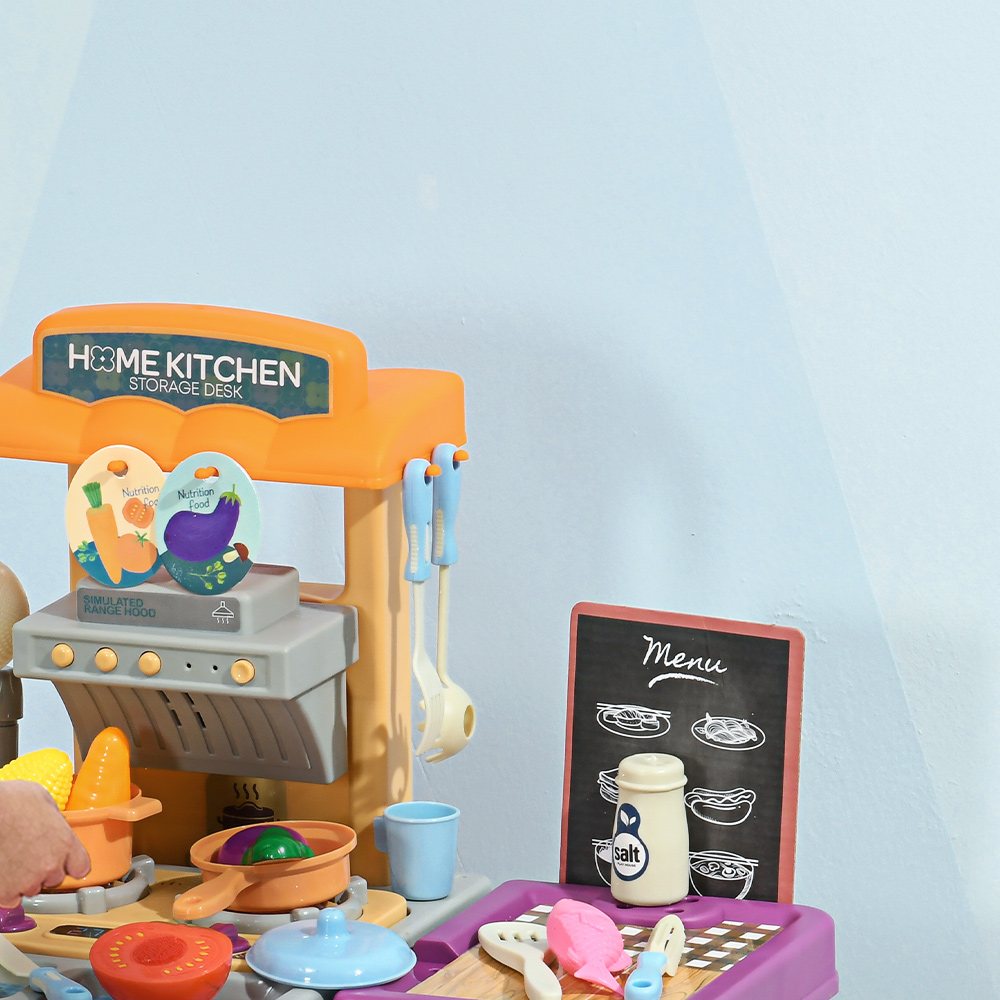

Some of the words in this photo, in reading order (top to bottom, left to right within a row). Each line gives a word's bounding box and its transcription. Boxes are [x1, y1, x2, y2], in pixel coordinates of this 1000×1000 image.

[166, 351, 301, 388] KITCHEN
[129, 376, 200, 396] STORAGE
[204, 383, 243, 399] DESK
[122, 485, 160, 498] Nutrition
[178, 487, 215, 500] Nutrition
[189, 497, 210, 512] food
[83, 595, 144, 608] SIMULATED
[84, 604, 122, 616] RANGE
[124, 607, 156, 618] HOOD
[642, 635, 728, 674] Menu
[614, 843, 641, 863] salt
